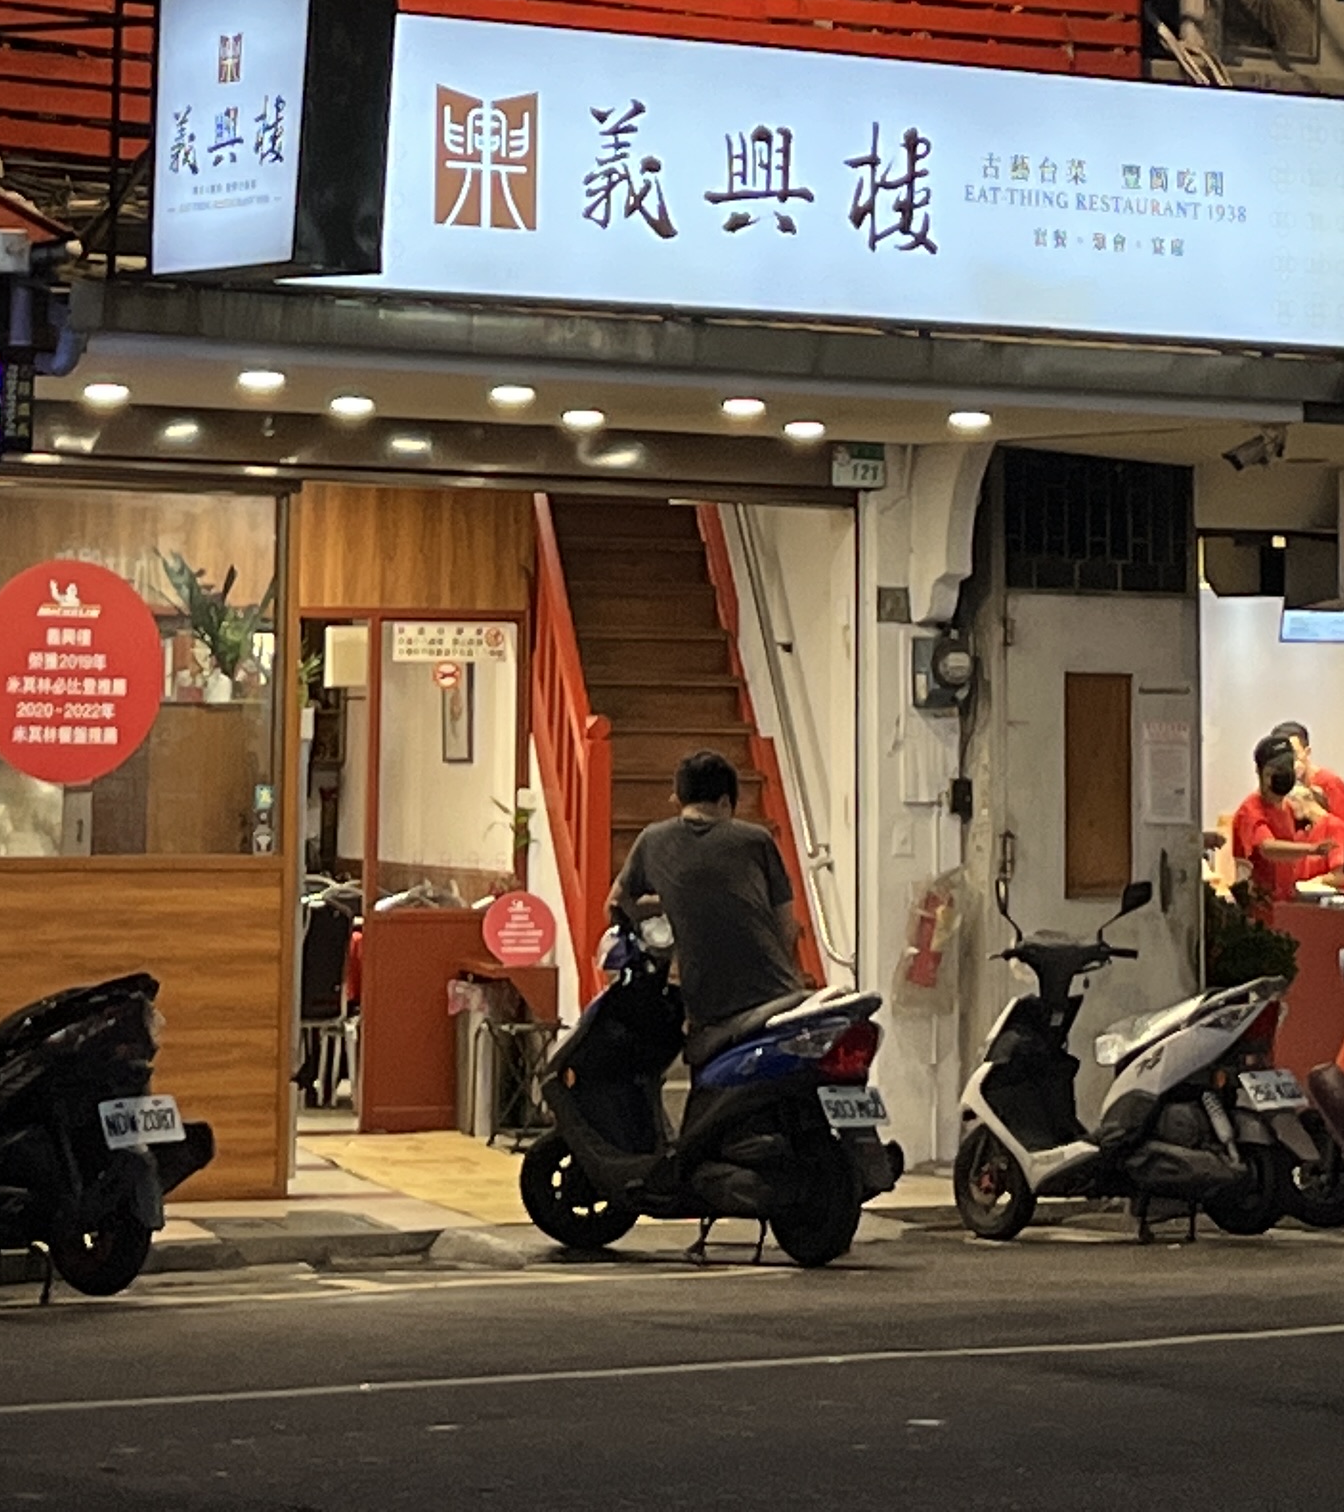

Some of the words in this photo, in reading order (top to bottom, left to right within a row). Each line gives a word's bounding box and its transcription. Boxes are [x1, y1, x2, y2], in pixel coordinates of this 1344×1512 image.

[168, 94, 284, 175] 義興樓
[582, 98, 940, 256] 義興樓
[1076, 188, 1202, 221] RESTAURANT
[1207, 201, 1248, 223] 1938
